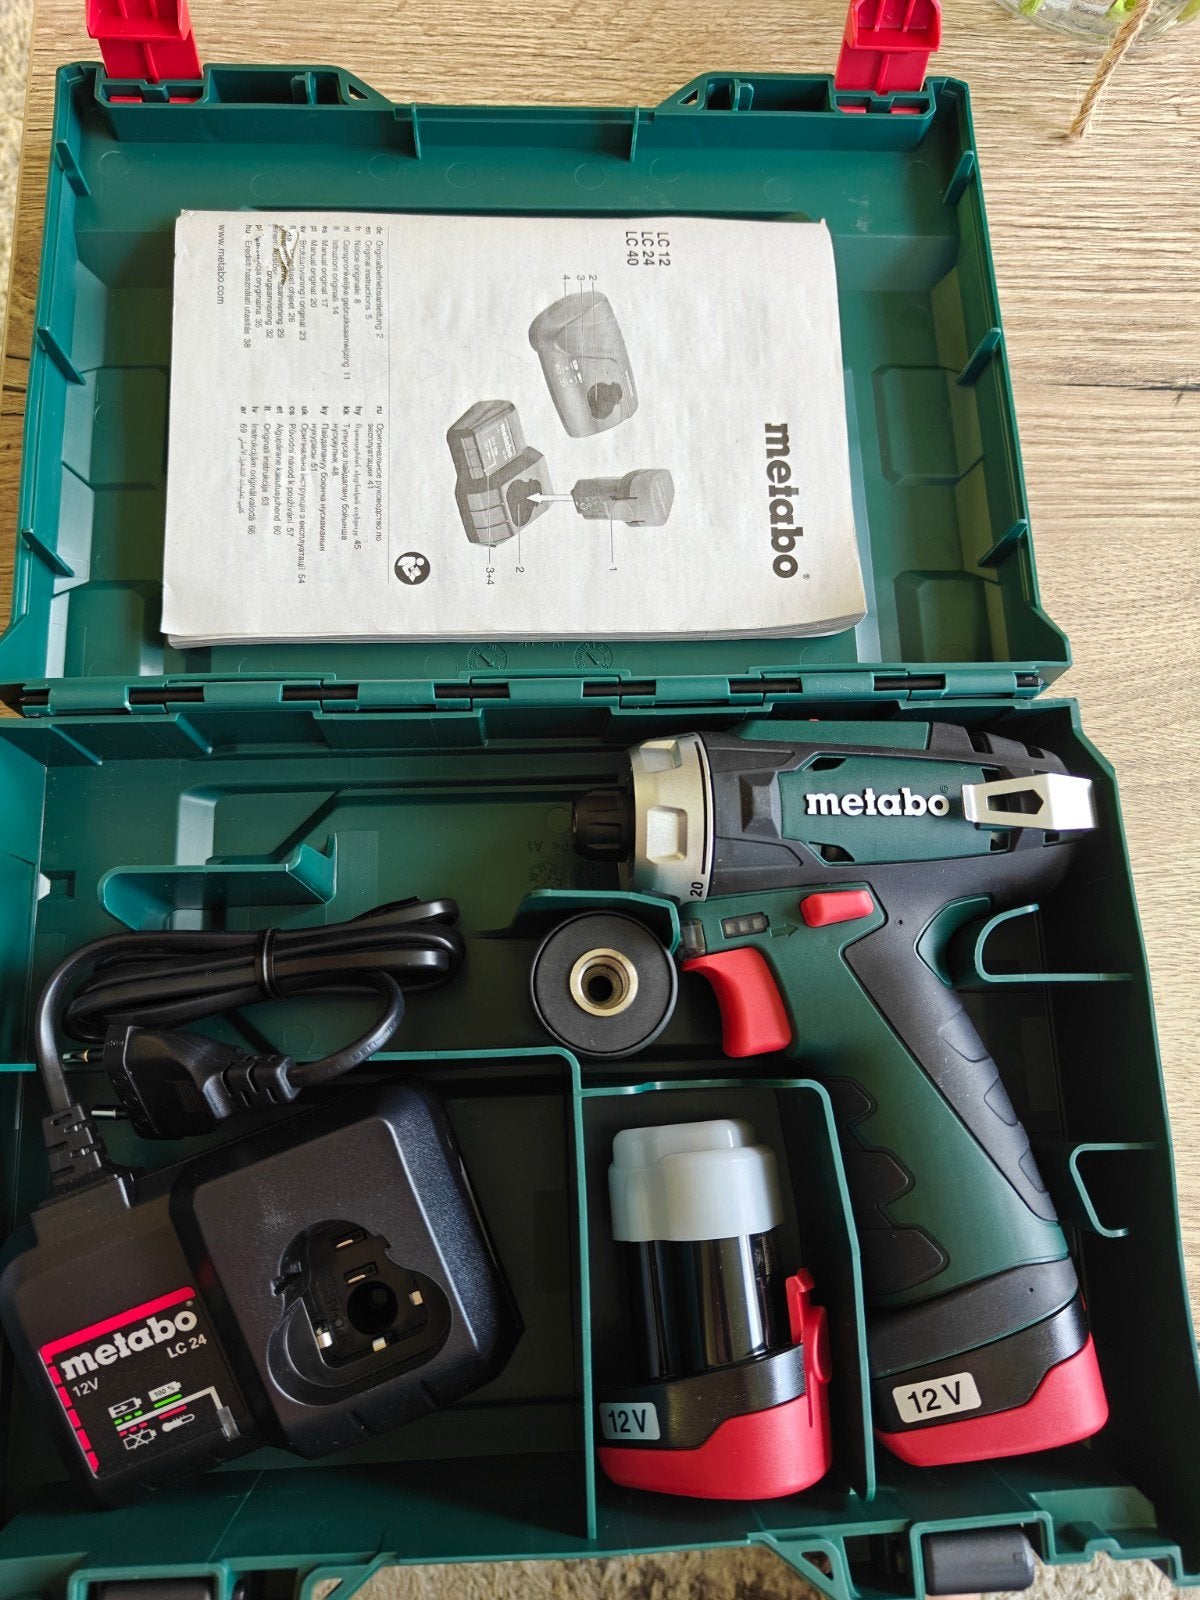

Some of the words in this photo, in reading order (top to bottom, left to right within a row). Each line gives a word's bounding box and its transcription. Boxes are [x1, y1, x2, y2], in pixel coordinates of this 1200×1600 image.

[246, 225, 252, 233] hu
[625, 231, 637, 245] LC
[642, 231, 653, 245] LC
[658, 231, 669, 245] LC
[627, 249, 638, 266] 40
[643, 249, 654, 266] 24
[659, 249, 670, 266] 12
[217, 225, 226, 304] www.metabo.com
[375, 240, 383, 330] Originalbetriebsanleitung
[310, 298, 316, 308] 20
[322, 299, 327, 307] 17
[332, 306, 338, 314] 14
[288, 313, 295, 322] 26
[256, 319, 261, 328] 35
[267, 330, 273, 338] 32
[278, 328, 284, 338] 29
[300, 331, 306, 341] 23
[244, 339, 250, 347] 38
[241, 406, 247, 414] ar
[289, 406, 294, 415] cs
[302, 406, 307, 415] uk
[320, 406, 328, 415] ky
[344, 406, 349, 415] kk
[354, 406, 362, 415] hy
[240, 424, 247, 433] 69
[262, 424, 270, 453] Originali
[375, 424, 383, 479] Оригинальное
[311, 464, 318, 472] 51
[333, 467, 338, 475] 48
[261, 456, 270, 492] instrukcija
[367, 480, 373, 489] 41
[272, 468, 282, 522] kasutusjuhend
[262, 497, 269, 506] 63
[764, 423, 803, 578] metabo
[249, 526, 255, 534] 66
[274, 526, 281, 535] 60
[287, 528, 294, 537] 57
[376, 532, 382, 541] по
[354, 540, 361, 549] 45
[298, 574, 305, 584] 54
[486, 567, 494, 585] 3+4
[806, 788, 950, 816] metabo
[690, 882, 703, 898] 20
[60, 1310, 198, 1380] metabo
[166, 1342, 187, 1359] LC
[188, 1334, 207, 1350] 24
[72, 1377, 99, 1398] 12V
